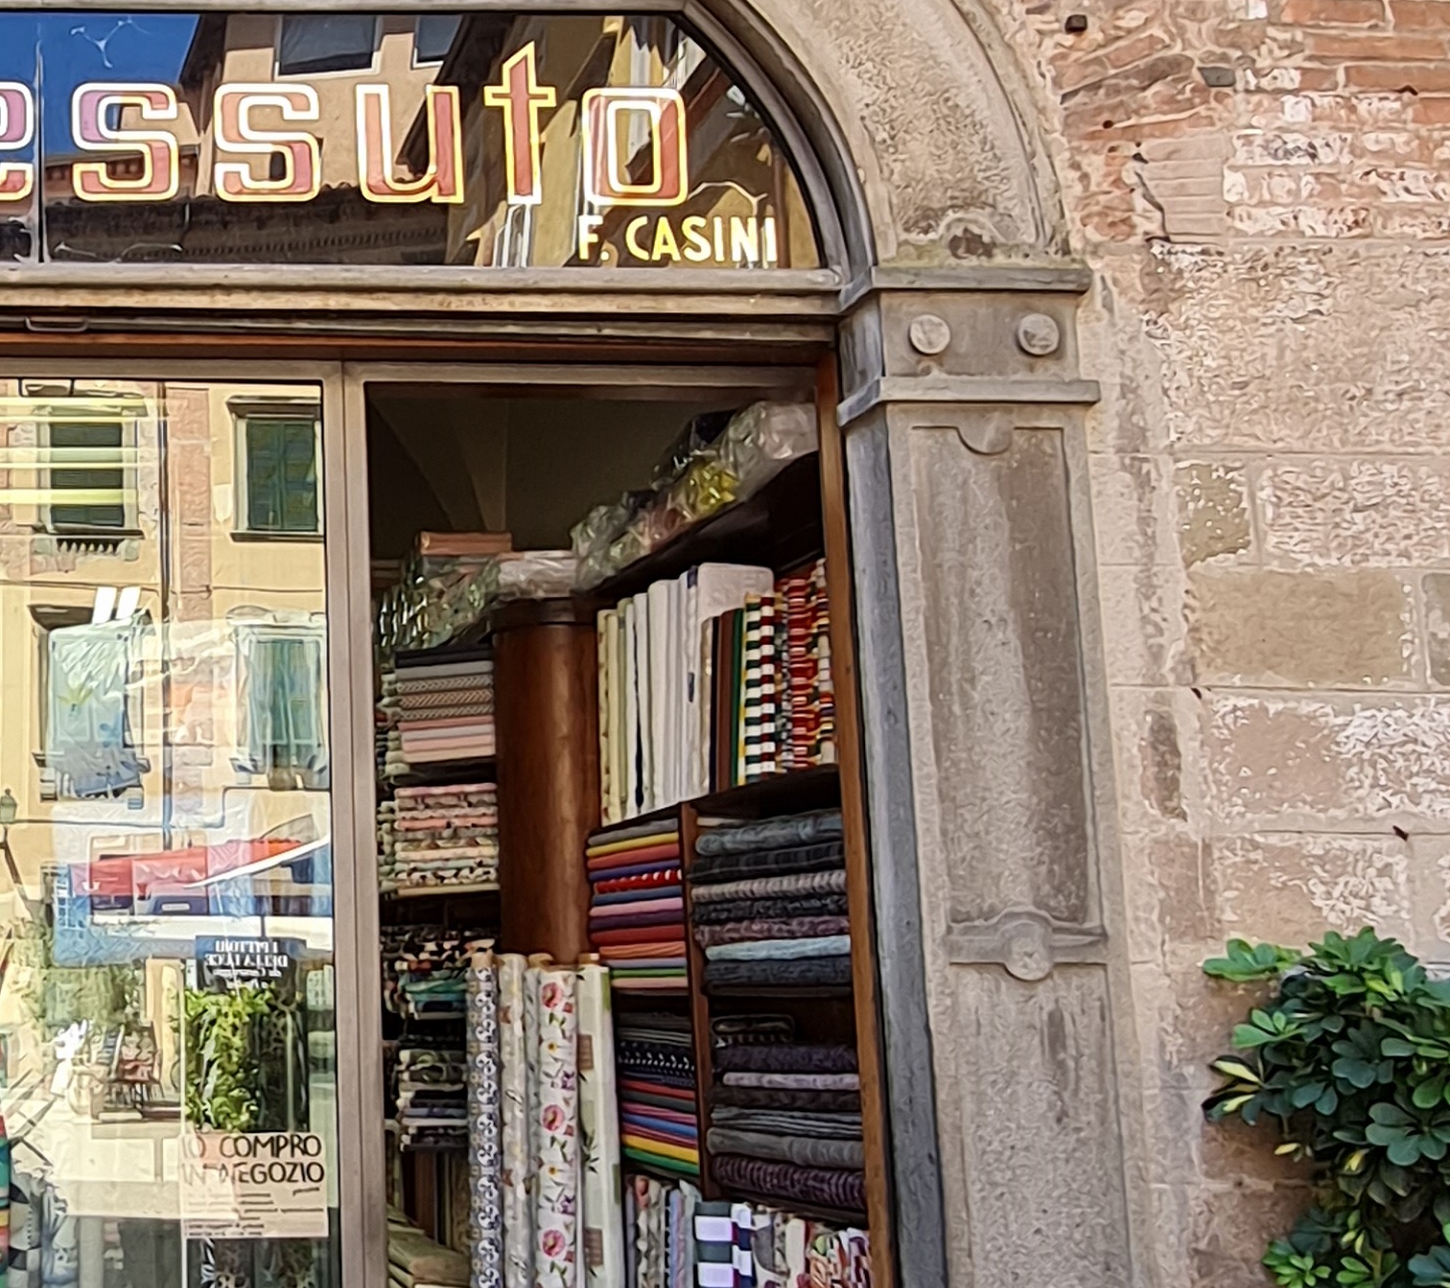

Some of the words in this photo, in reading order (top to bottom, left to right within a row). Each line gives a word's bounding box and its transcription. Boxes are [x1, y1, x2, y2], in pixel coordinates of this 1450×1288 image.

[578, 214, 611, 261] F.
[624, 214, 779, 263] CASINI
[219, 1133, 323, 1159] COMPRO
[218, 1160, 326, 1186] NEGOZIO
